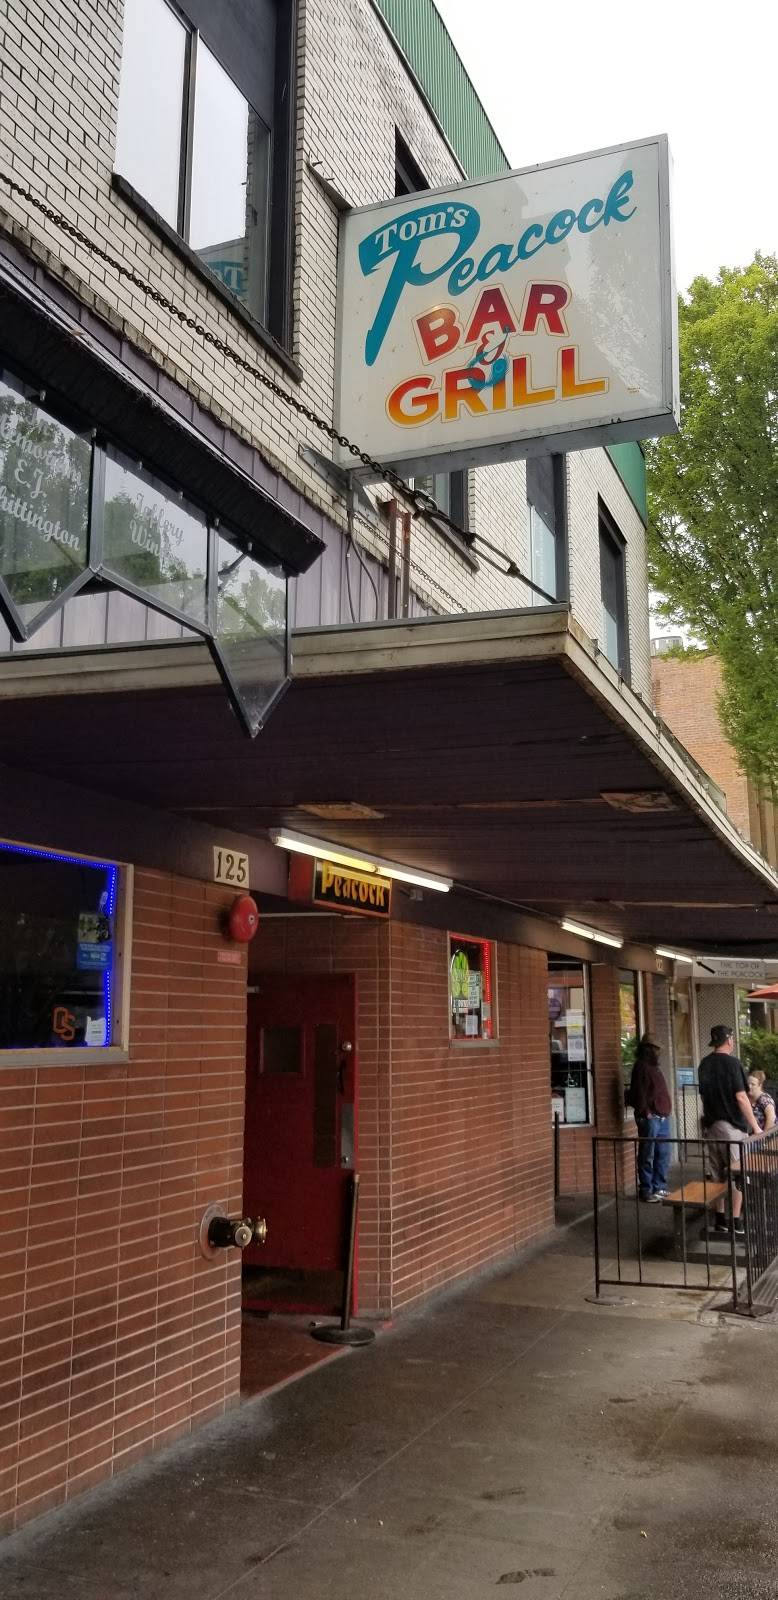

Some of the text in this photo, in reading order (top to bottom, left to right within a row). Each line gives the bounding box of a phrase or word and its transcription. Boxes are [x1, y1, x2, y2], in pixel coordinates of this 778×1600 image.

[375, 206, 470, 255] Tom's
[358, 170, 638, 367] Peacock
[414, 282, 570, 364] BAR
[387, 346, 608, 427] GRILL
[216, 850, 248, 883] 125
[321, 860, 386, 907] Peacock
